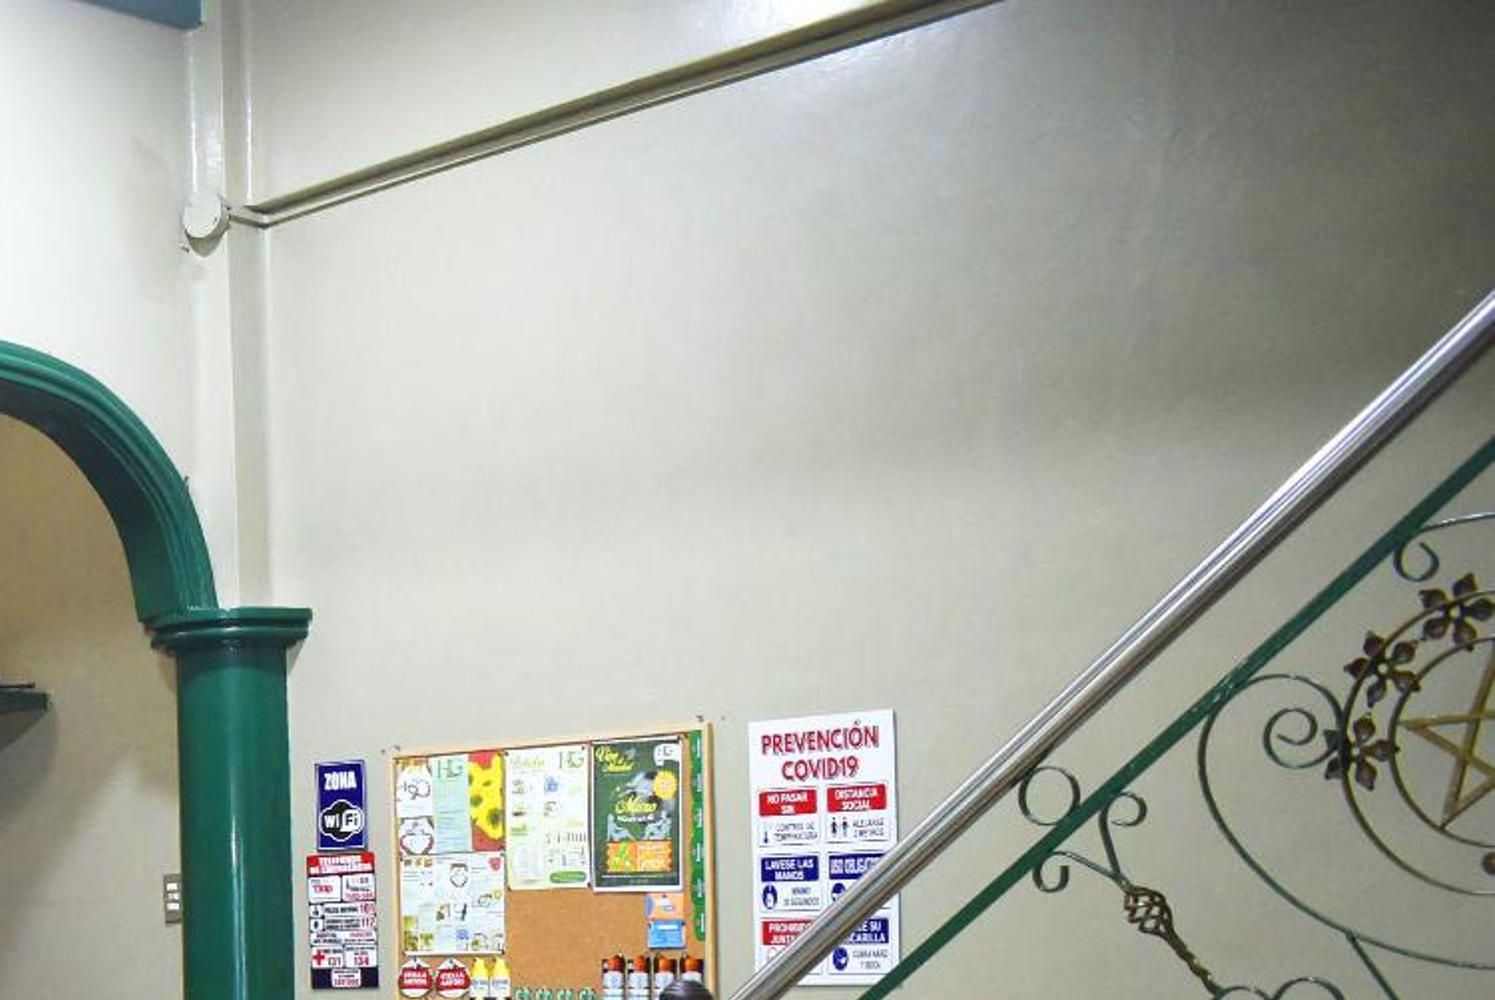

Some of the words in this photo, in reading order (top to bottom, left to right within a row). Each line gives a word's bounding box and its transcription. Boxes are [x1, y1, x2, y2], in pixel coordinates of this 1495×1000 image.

[761, 720, 880, 757] PREVENCIÓN
[781, 755, 859, 782] COVID19
[324, 771, 357, 790] ZONA
[766, 793, 780, 804] NO
